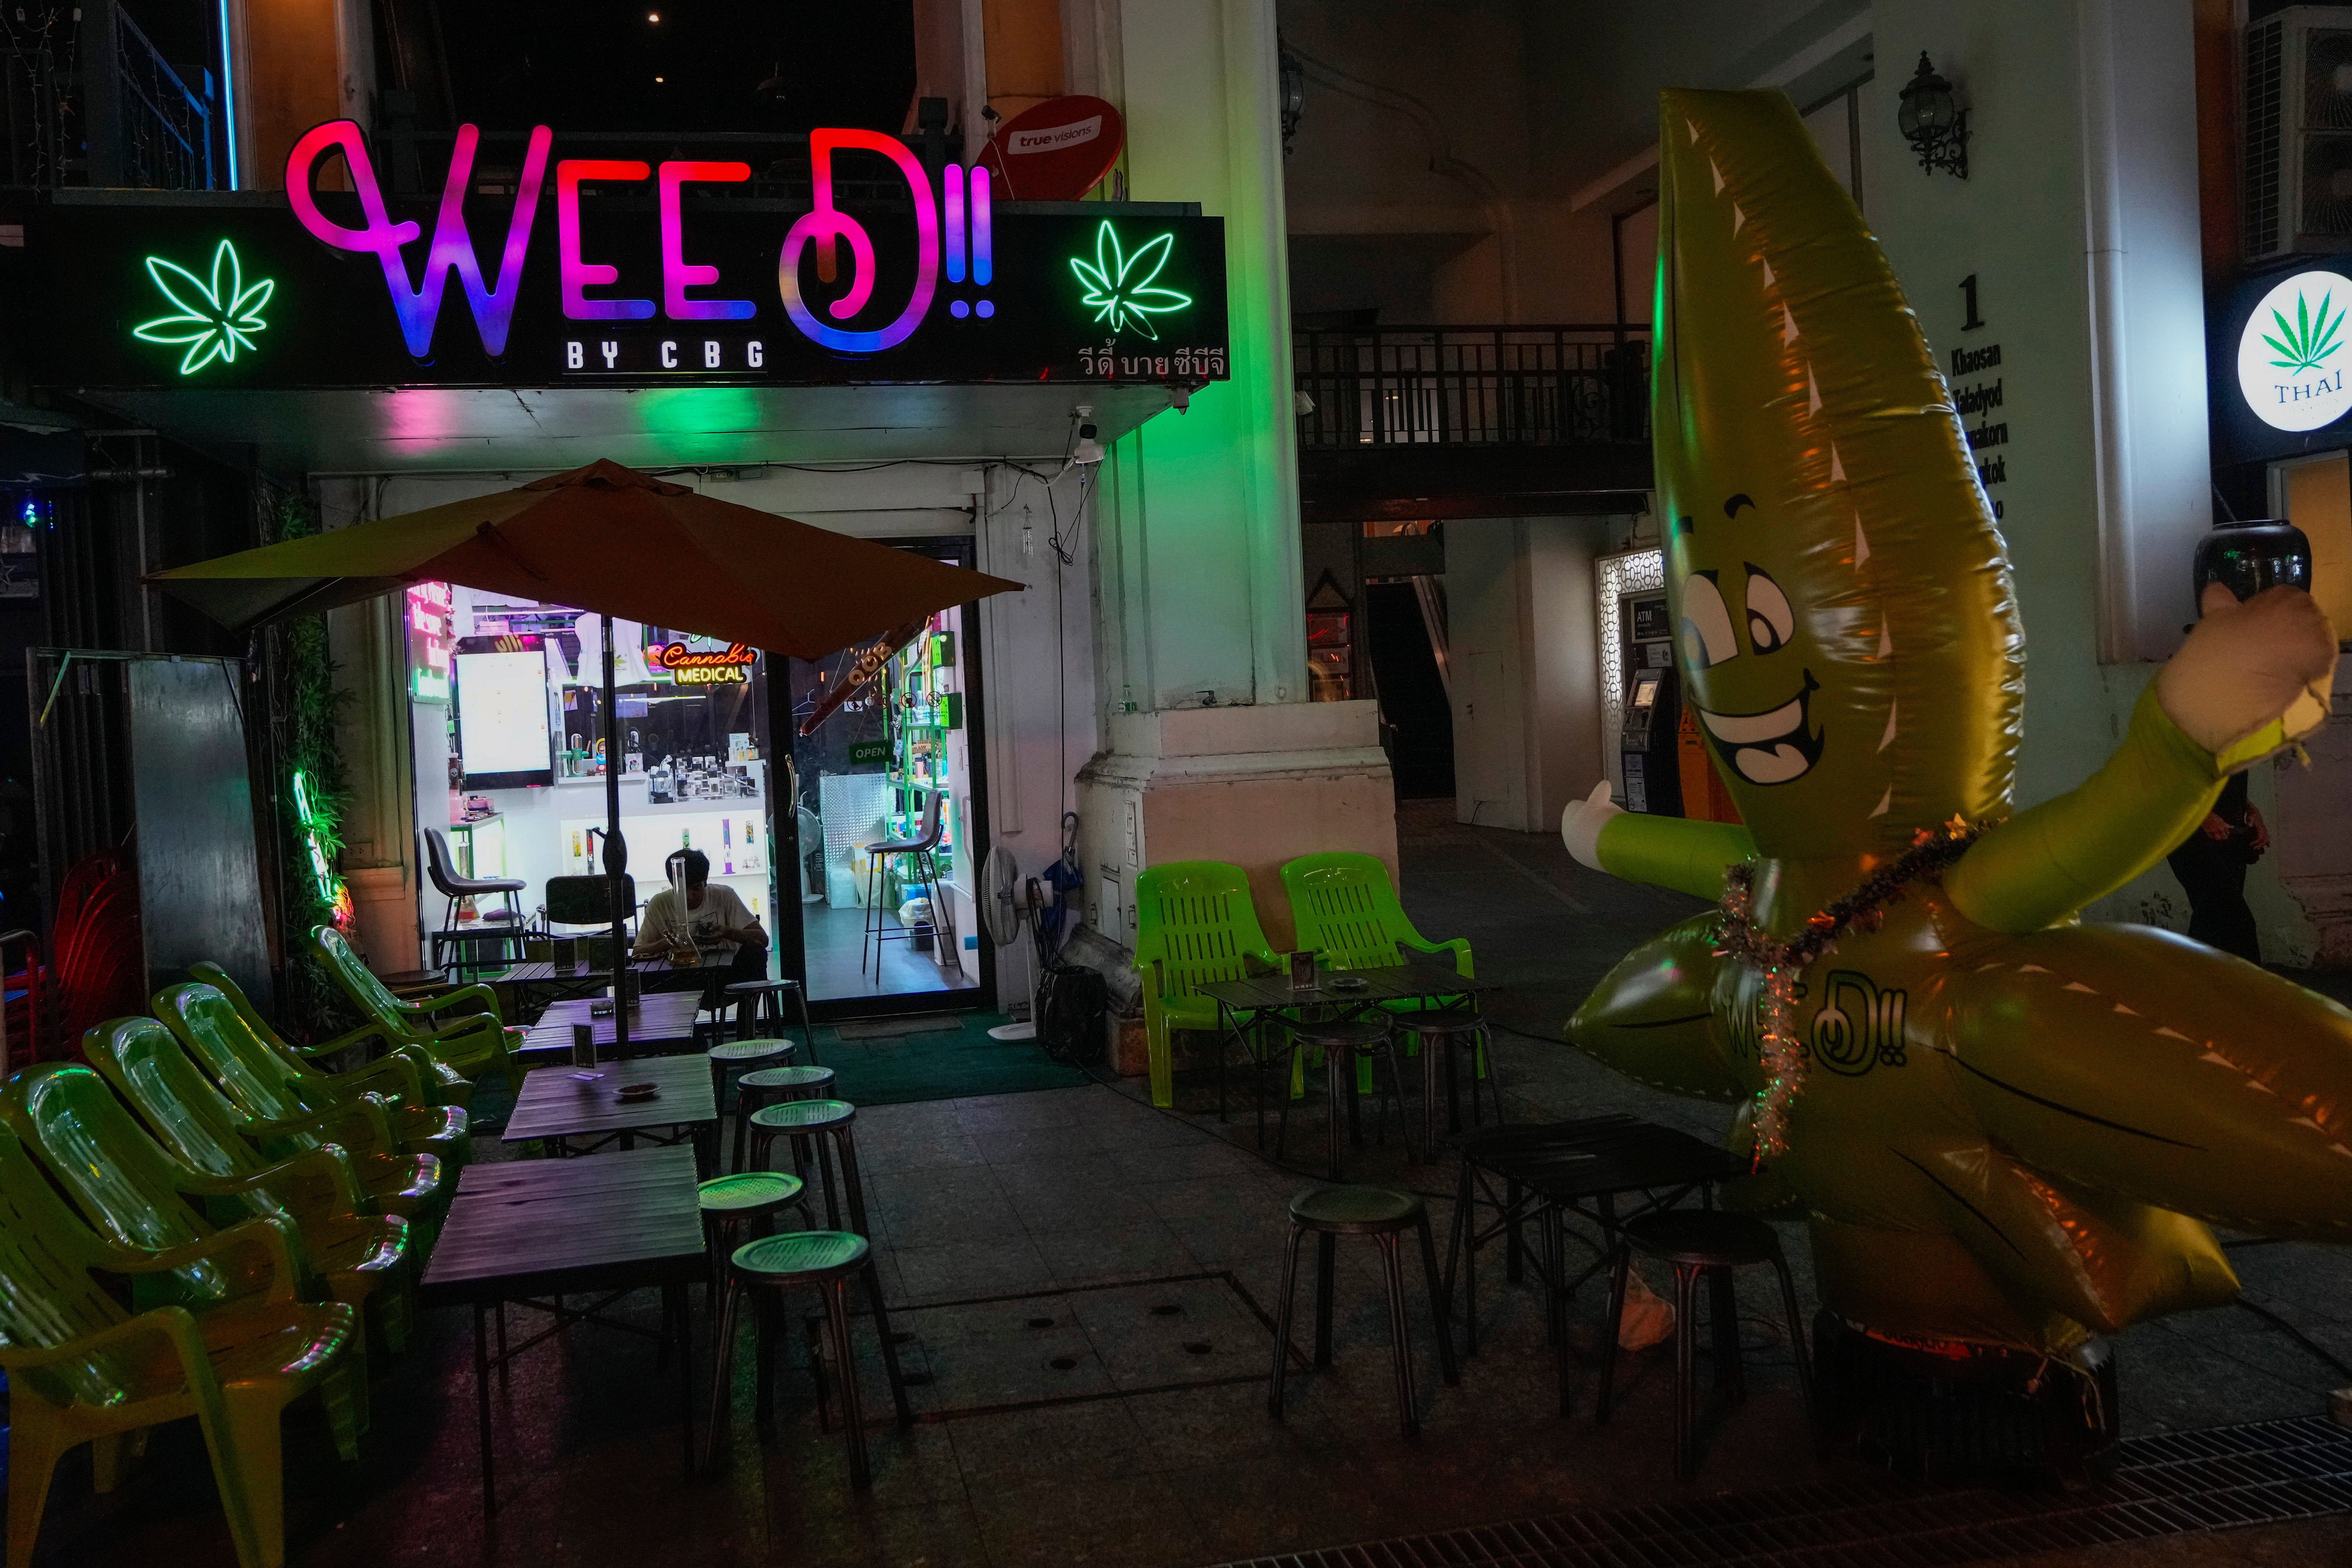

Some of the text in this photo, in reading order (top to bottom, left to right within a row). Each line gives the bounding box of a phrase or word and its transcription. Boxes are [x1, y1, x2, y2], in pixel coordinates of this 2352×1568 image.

[1020, 125, 1092, 147] true visions
[1959, 274, 1984, 332] 1
[568, 341, 762, 368] BY CBG
[1078, 338, 1224, 375] วีดี้ บาย ซีบีจี
[1951, 344, 2001, 377] Khaosan
[1953, 378, 2003, 417] Taladyod
[2274, 368, 2342, 404] THAI
[1965, 421, 2008, 450] nakorn
[1637, 610, 1652, 622] ATM
[664, 643, 754, 666] Cannabis
[848, 642, 892, 686] OCB
[678, 666, 744, 682] MEDICAL
[855, 746, 886, 758] OPEN
